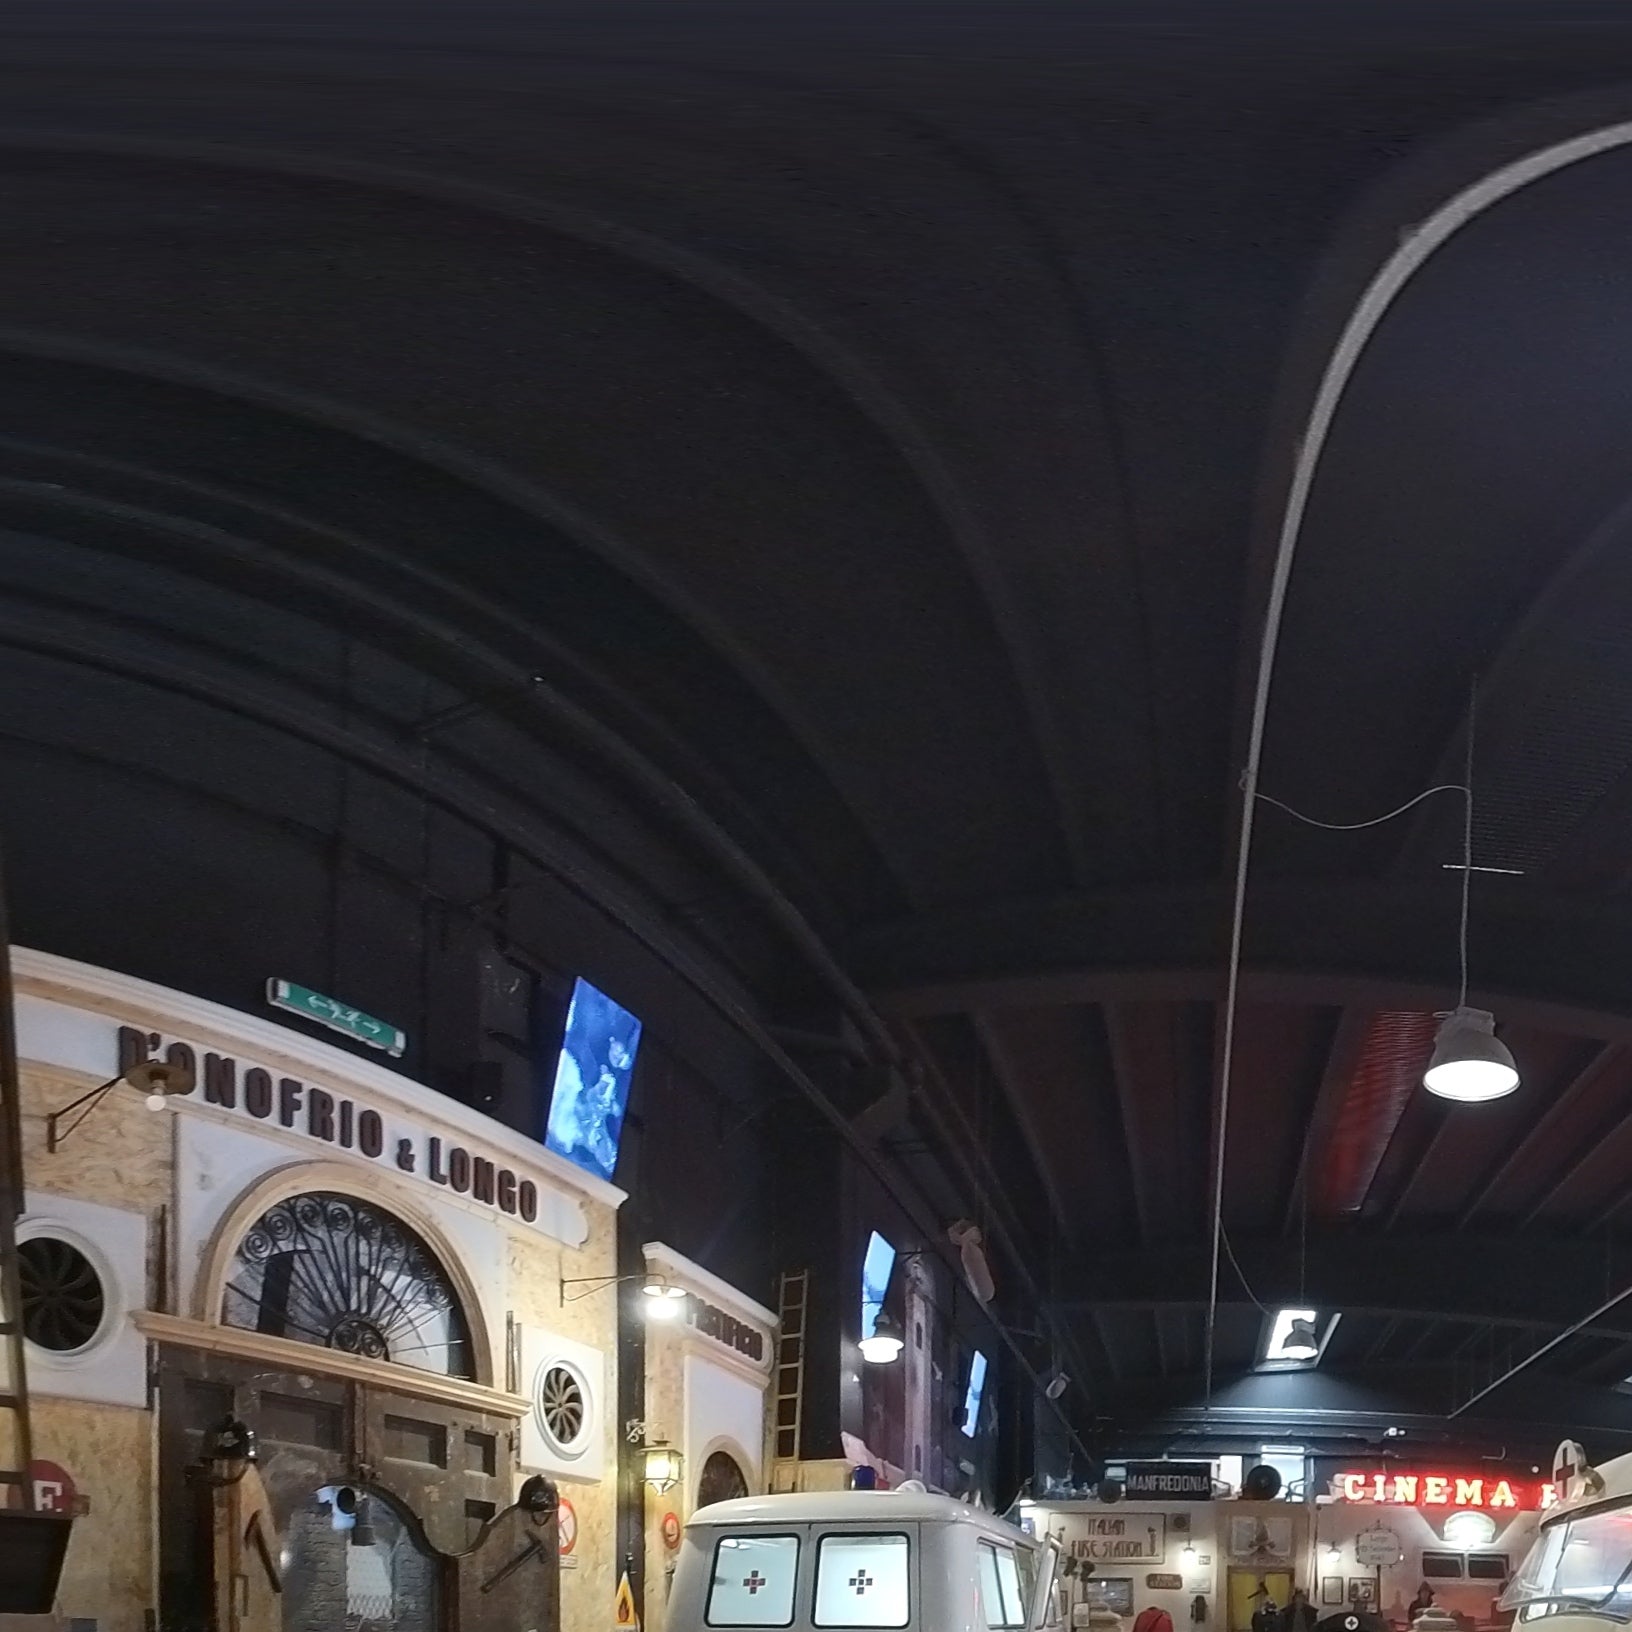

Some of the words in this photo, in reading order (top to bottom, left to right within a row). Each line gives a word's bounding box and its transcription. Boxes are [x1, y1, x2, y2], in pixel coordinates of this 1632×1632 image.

[397, 1138, 415, 1173] &
[429, 1136, 538, 1223] LONGO
[1127, 1475, 1209, 1492] MANFREDONIA
[1344, 1474, 1516, 1508] CINEMA
[1088, 1518, 1125, 1536] ITALIAN
